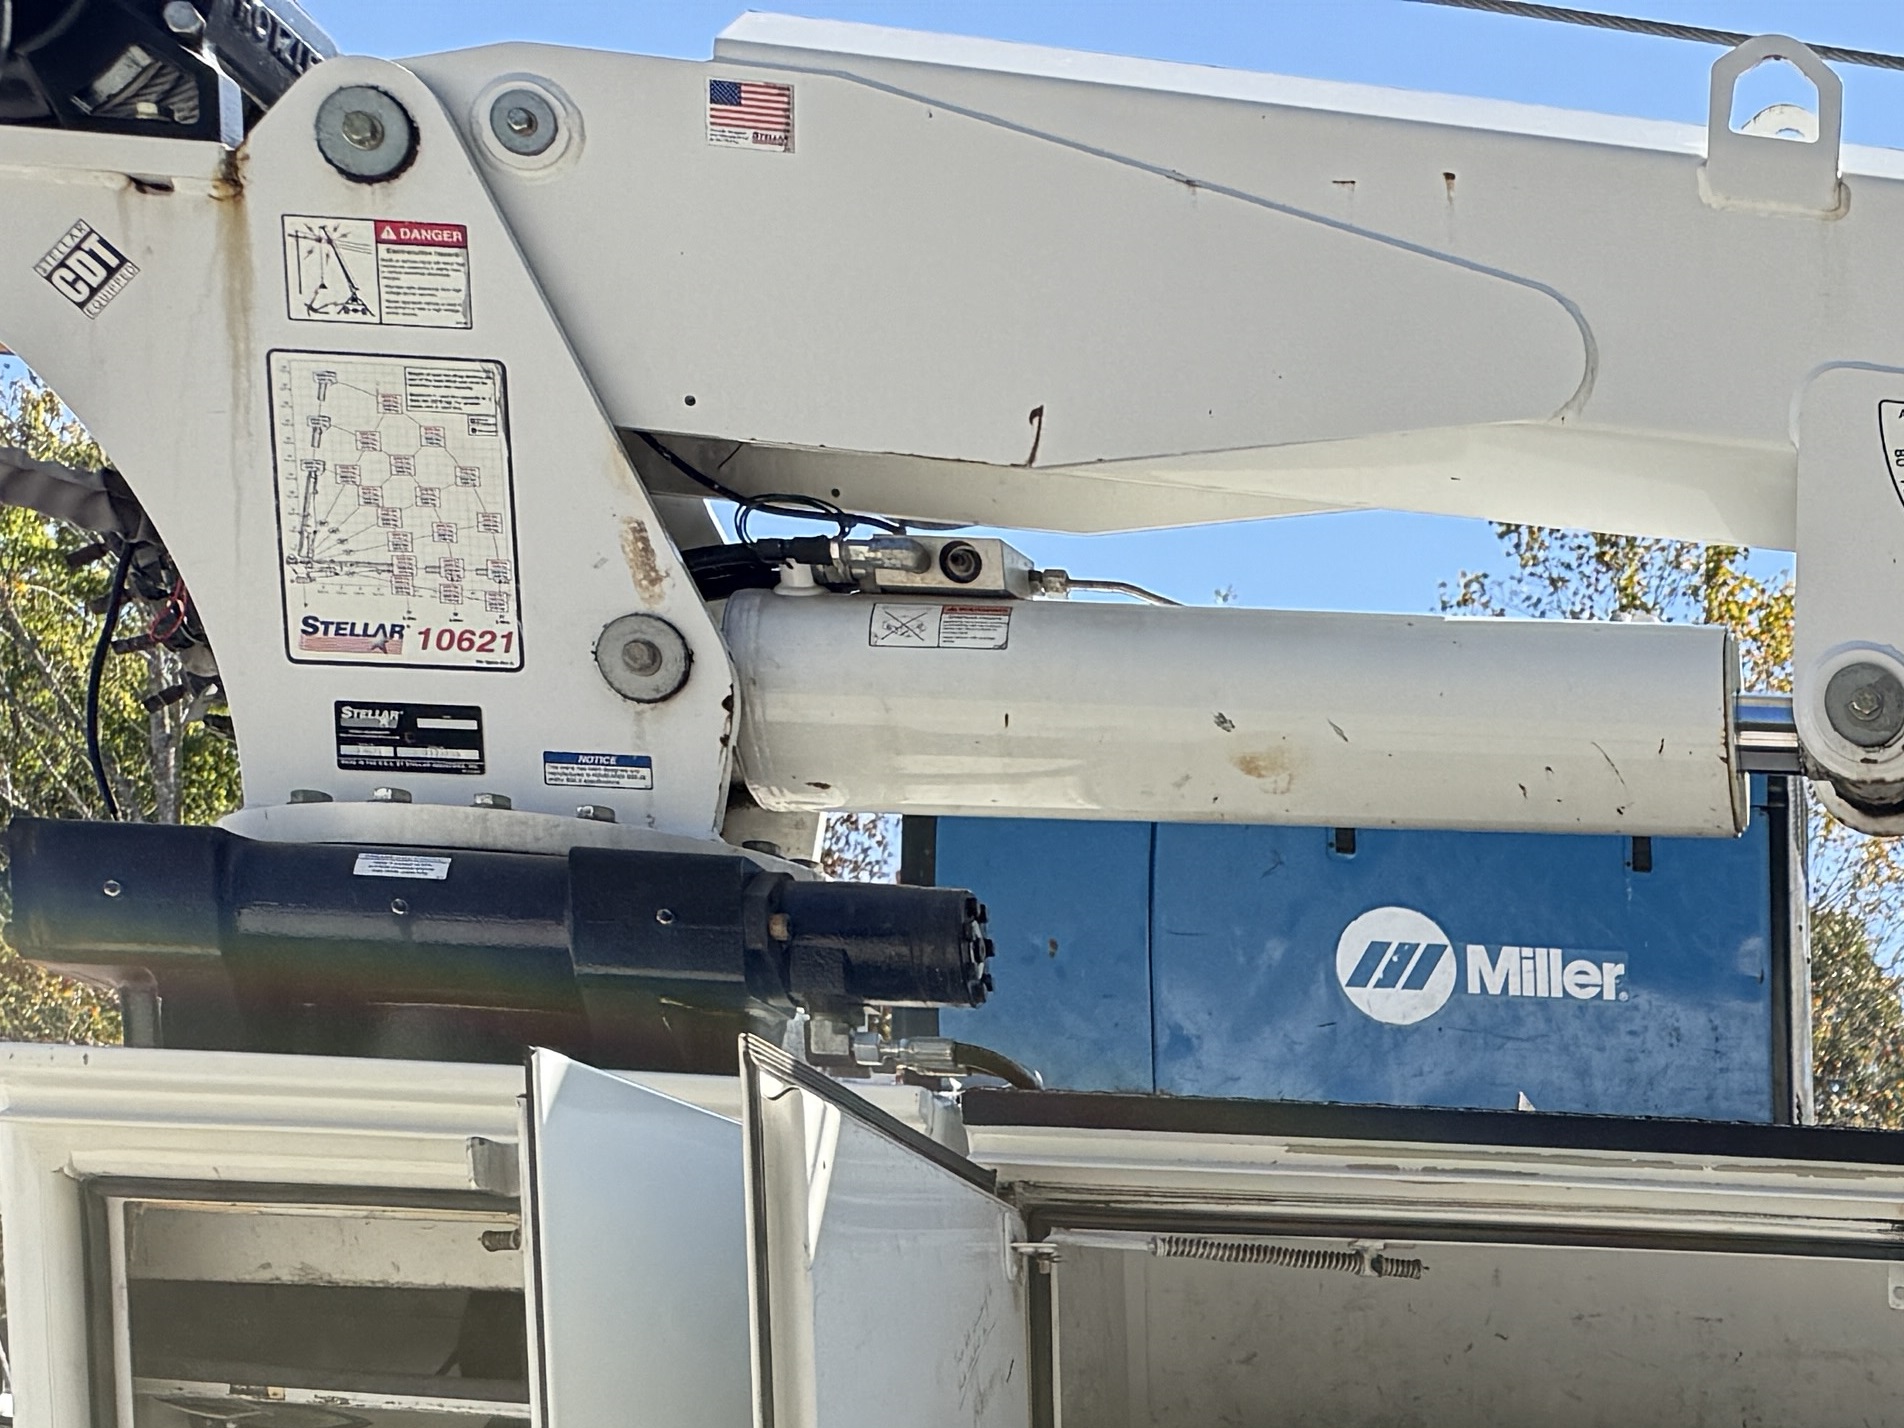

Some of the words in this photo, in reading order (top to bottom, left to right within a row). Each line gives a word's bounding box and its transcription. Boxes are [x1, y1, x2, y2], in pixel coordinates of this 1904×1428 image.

[399, 227, 462, 243] DANGER
[51, 232, 120, 303] CDT
[300, 615, 405, 640] STELLAR
[418, 627, 515, 654] 10621
[340, 705, 400, 720] STELLAR
[577, 754, 618, 765] NOTICE
[1466, 944, 1625, 1001] Miller
